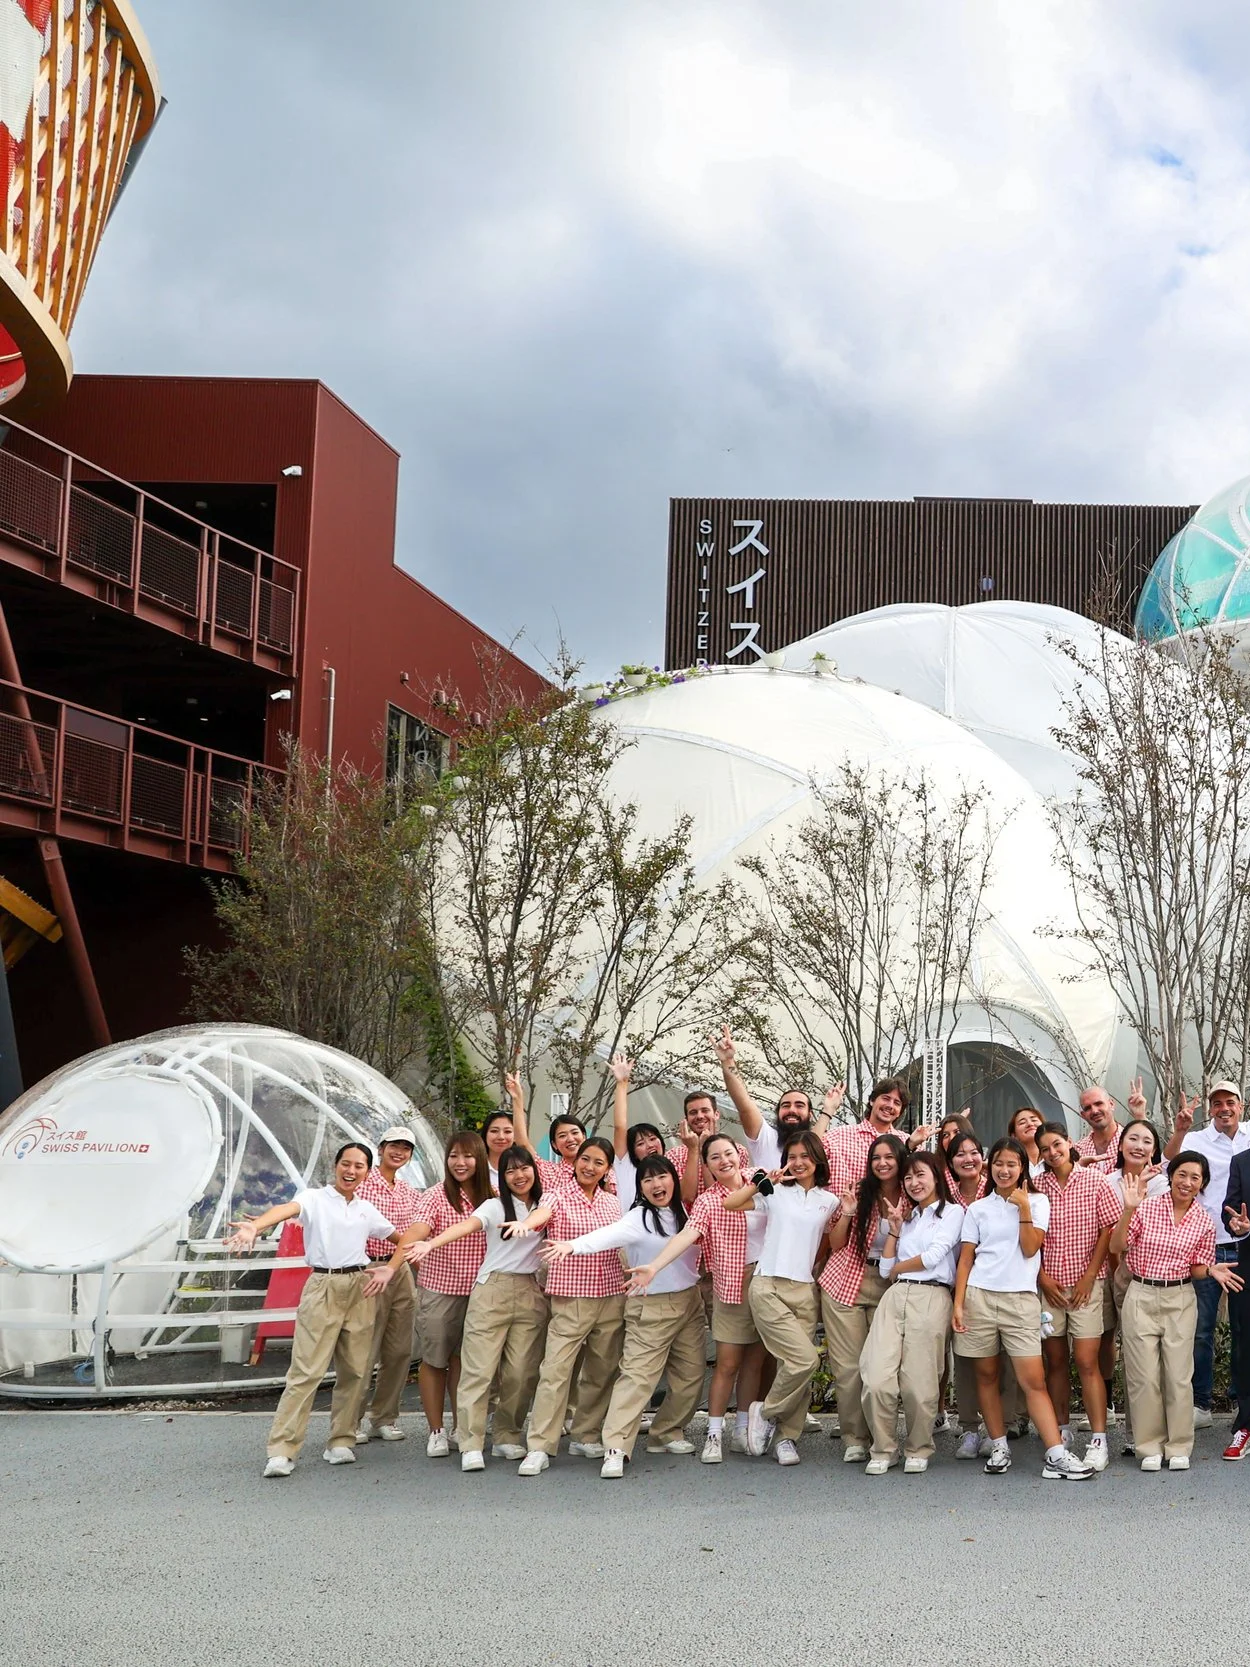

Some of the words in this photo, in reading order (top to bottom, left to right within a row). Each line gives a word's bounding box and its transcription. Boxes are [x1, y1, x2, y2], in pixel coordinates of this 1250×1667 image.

[725, 519, 770, 659] スイス
[46, 1130, 88, 1141] スイス館
[41, 1144, 79, 1153] SWISS
[81, 1143, 139, 1153] PAVILION
